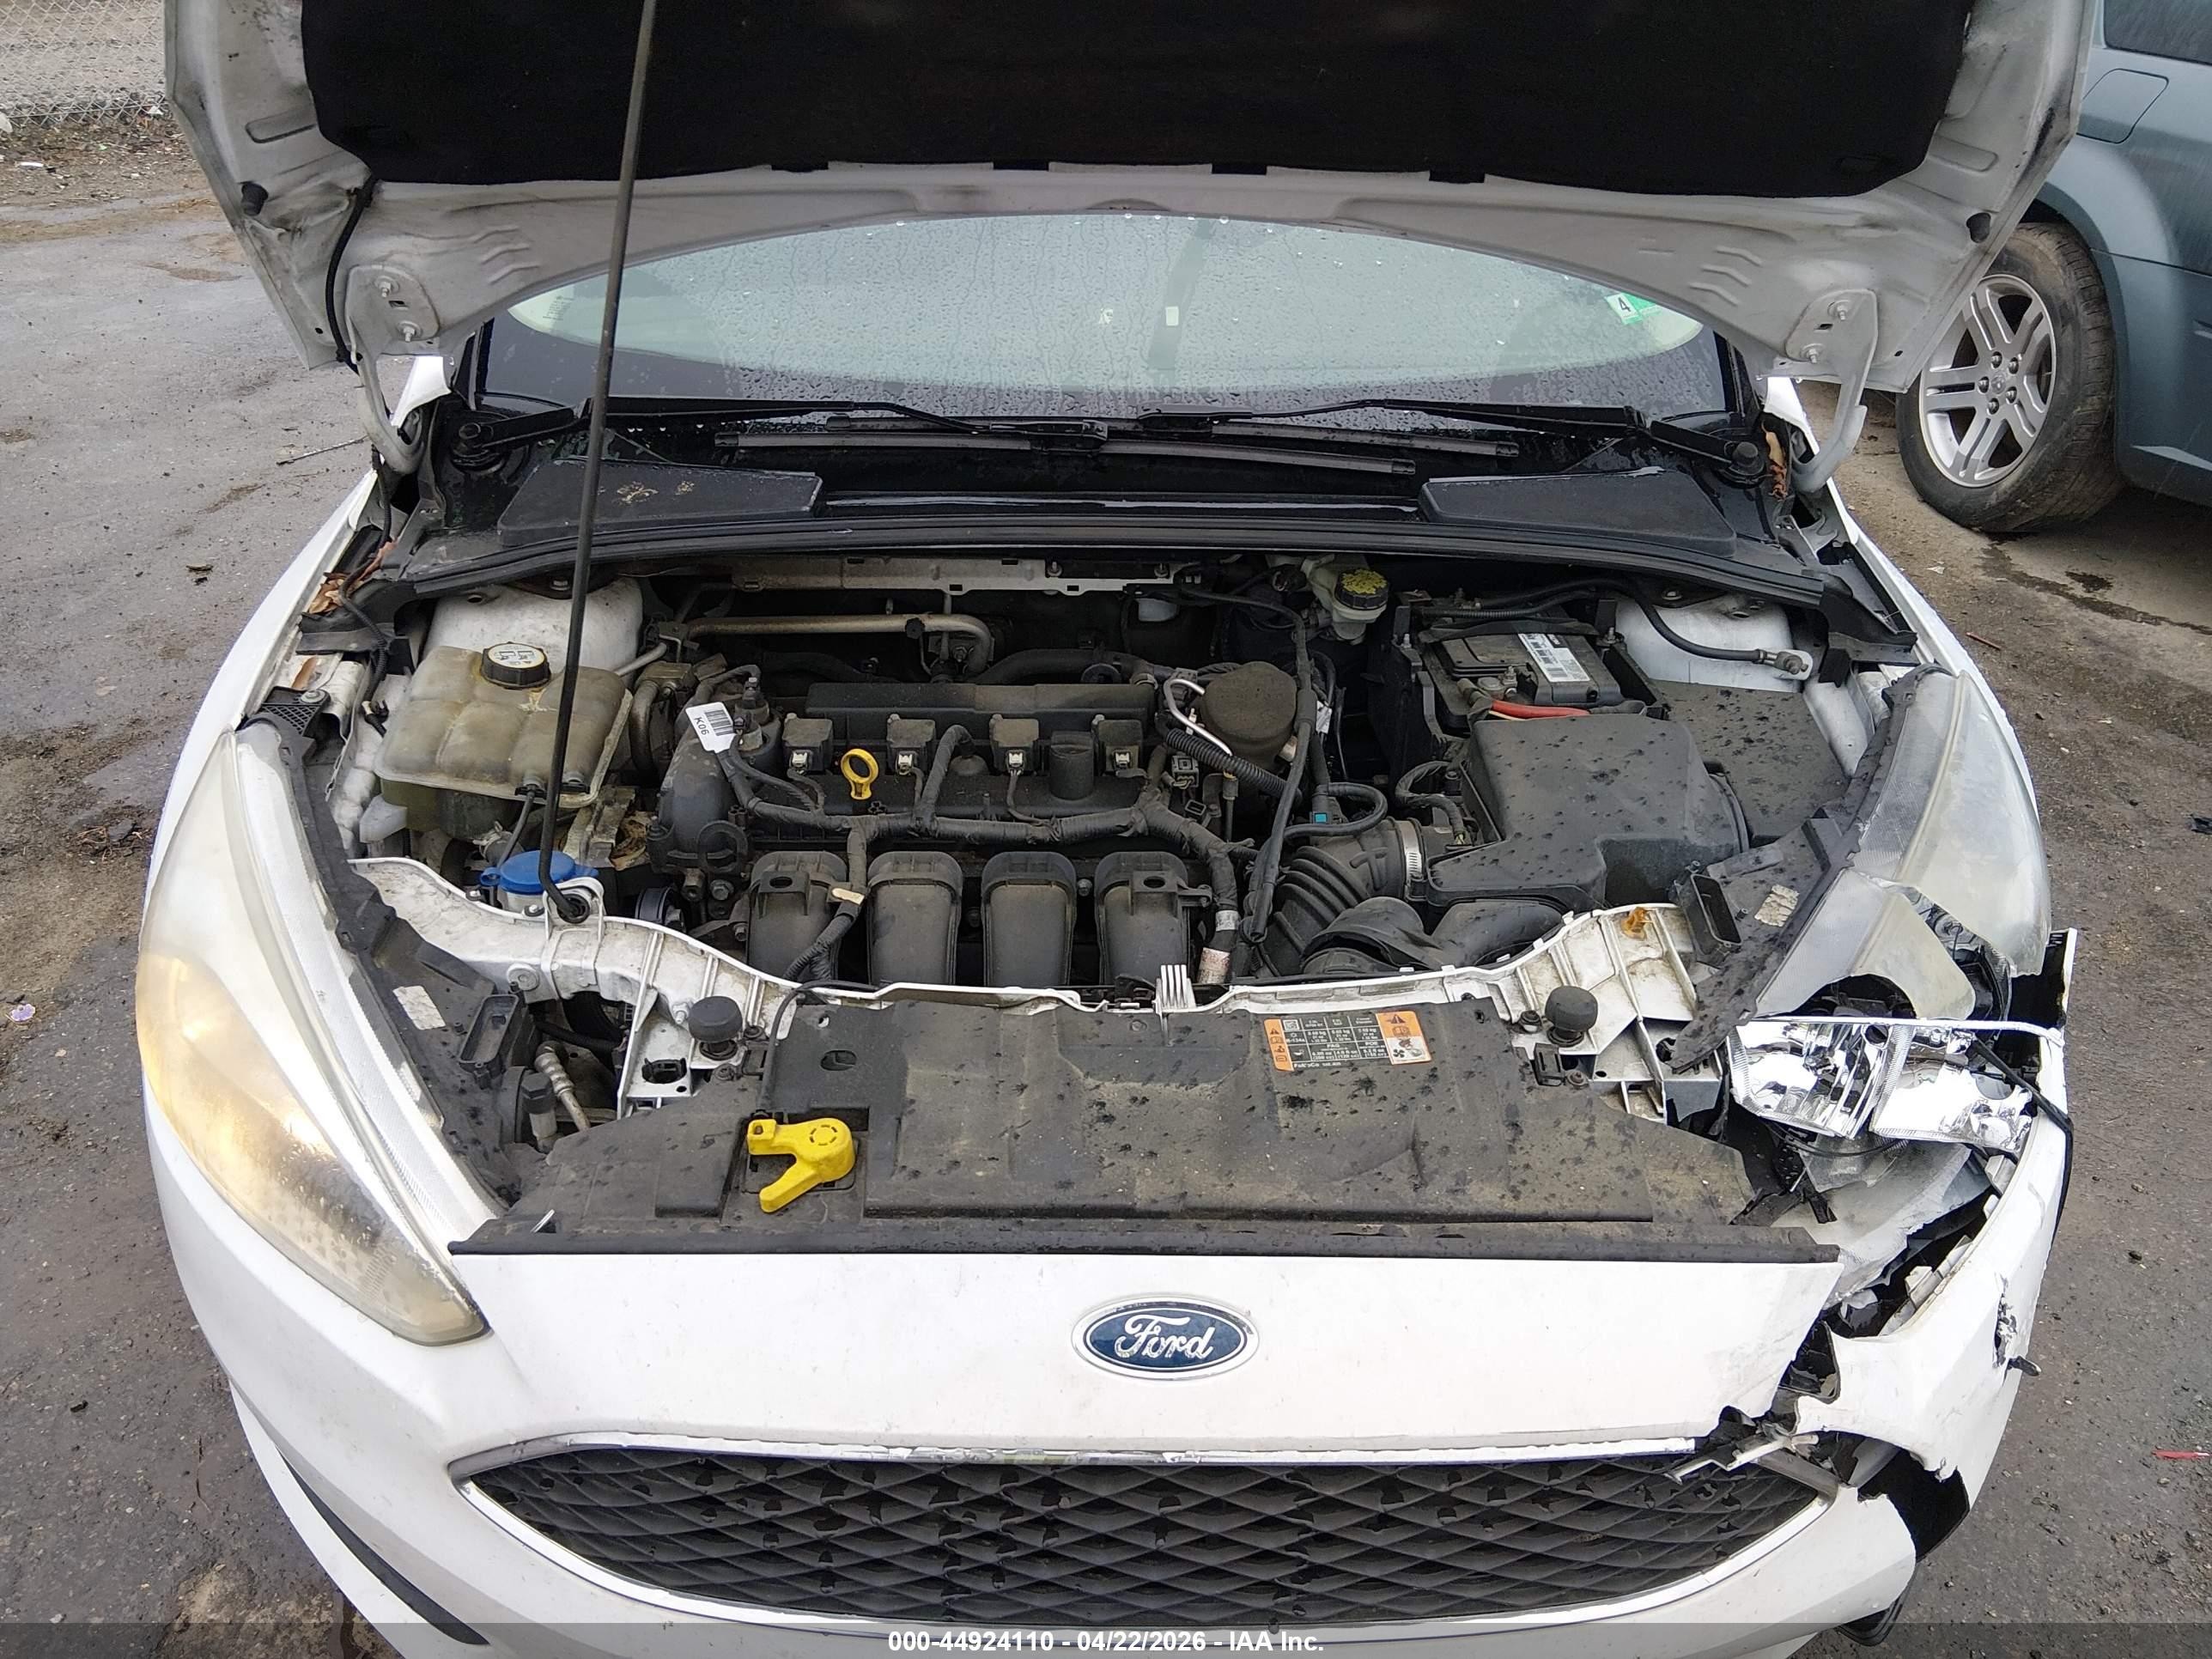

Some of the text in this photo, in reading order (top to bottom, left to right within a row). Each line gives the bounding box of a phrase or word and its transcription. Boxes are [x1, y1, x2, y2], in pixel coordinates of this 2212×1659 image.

[1617, 296, 1632, 313] 4
[693, 716, 710, 736] K06
[1114, 1314, 1216, 1358] Ford
